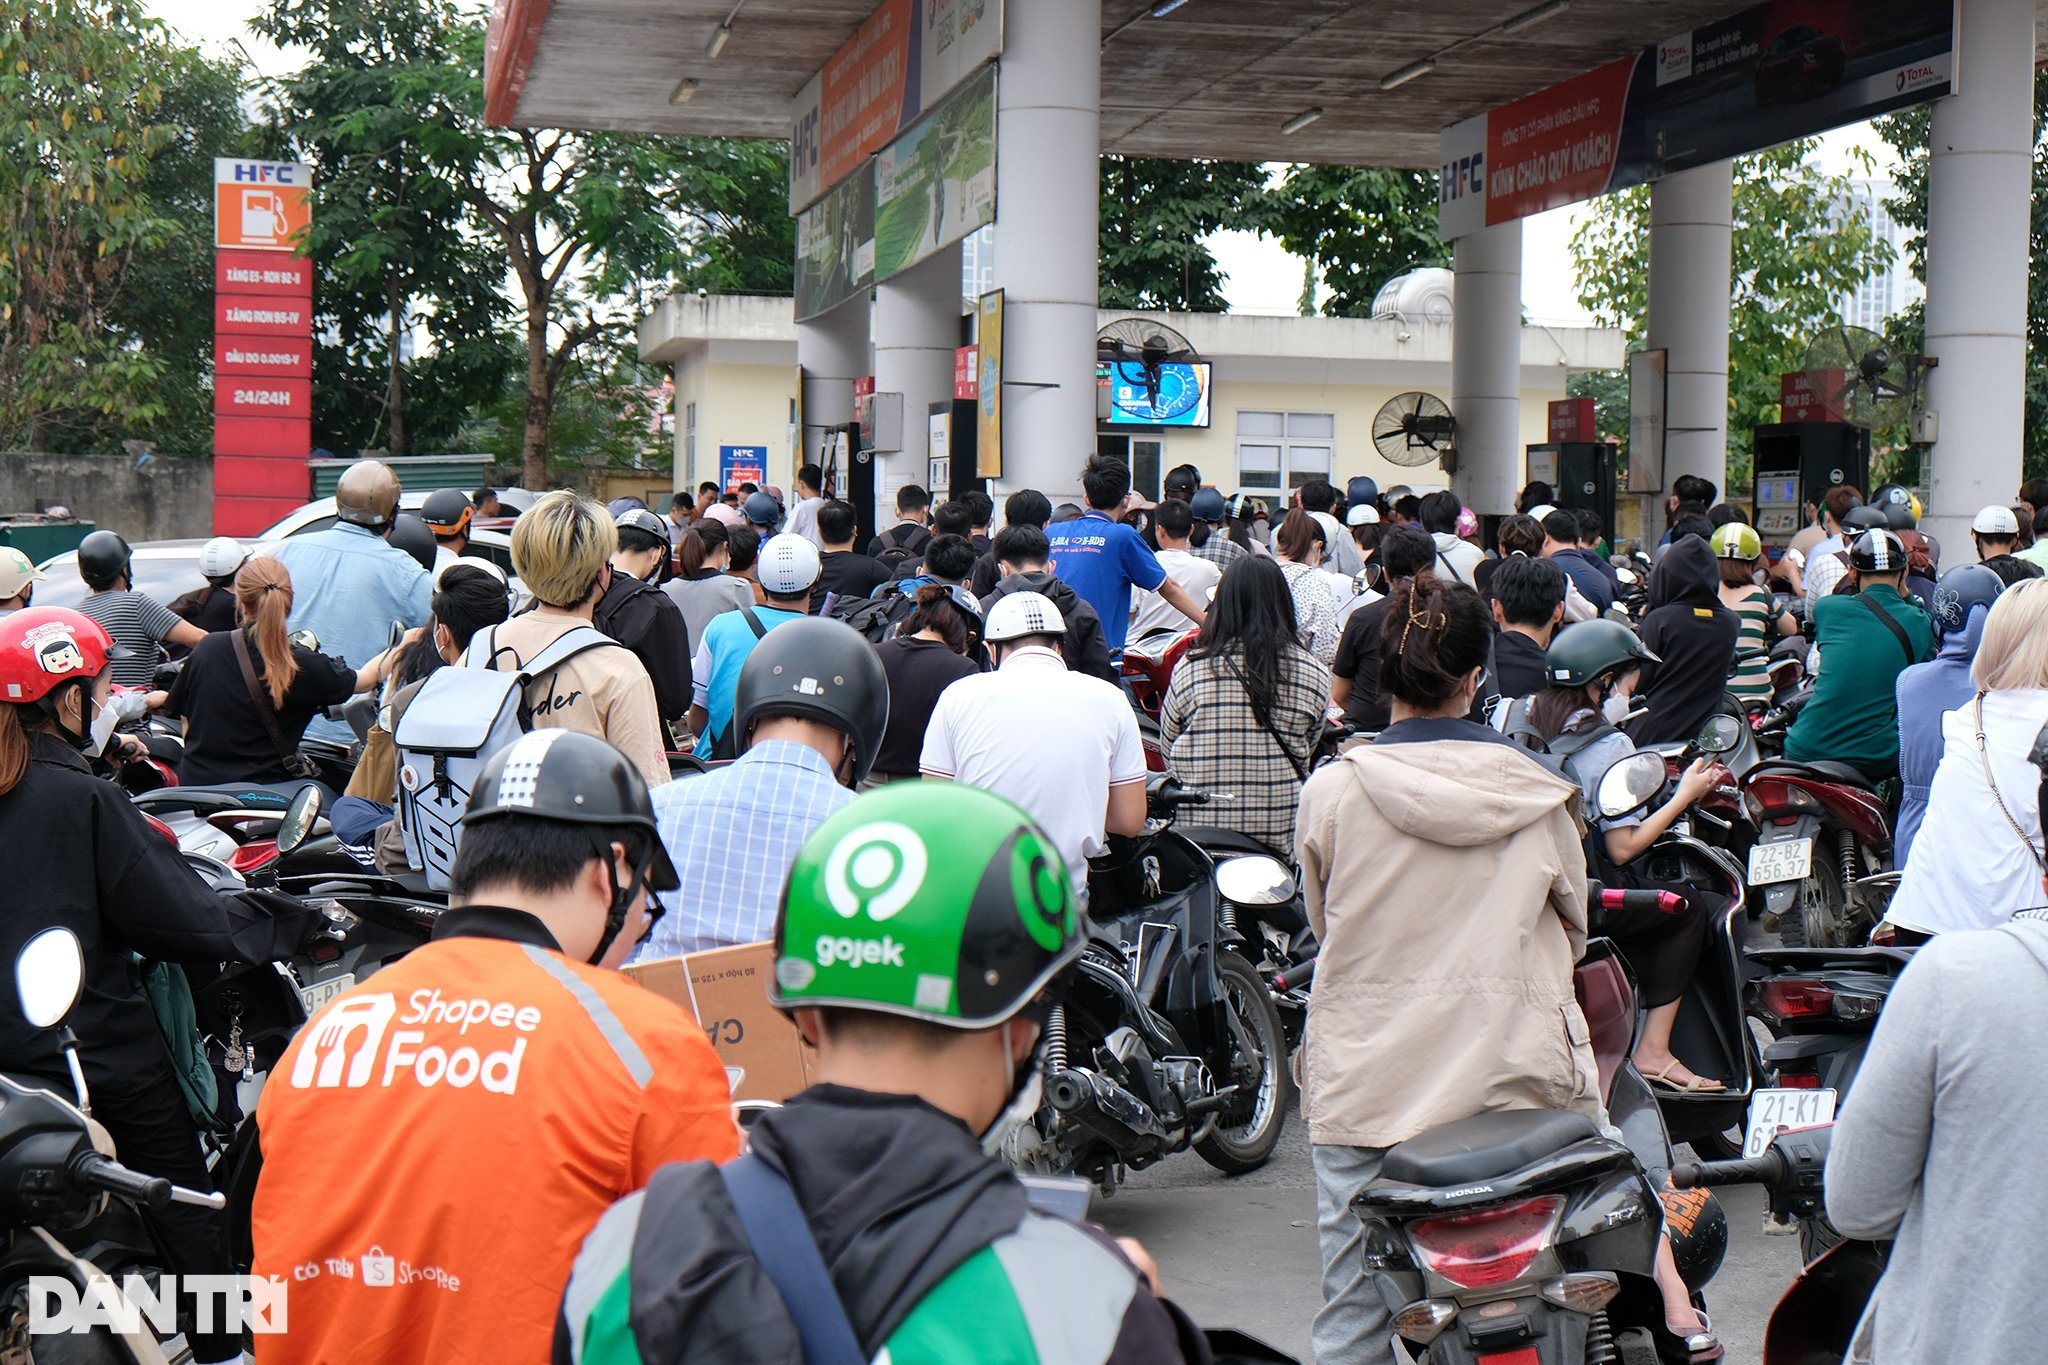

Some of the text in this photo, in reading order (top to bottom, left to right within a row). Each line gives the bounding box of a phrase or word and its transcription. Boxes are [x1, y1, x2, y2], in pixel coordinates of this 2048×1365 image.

[1667, 47, 1687, 58] TOTAL
[1906, 66, 1934, 80] TOTAL
[1520, 125, 1526, 140] TY
[1586, 97, 1600, 116] HFC
[792, 105, 818, 183] HFC
[235, 164, 293, 183] HFC
[1491, 131, 1612, 199] KÍNH CHÀO QUÝ KHÁCH
[1442, 152, 1482, 203] HFC
[234, 388, 290, 406] 24/24H
[1760, 843, 1801, 864] 22-B2
[1754, 860, 1806, 882] 656.37
[816, 934, 905, 968] gojek
[701, 974, 716, 984] 125
[726, 968, 743, 978] hộp
[744, 967, 756, 976] 80
[400, 988, 542, 1036] Shopee
[382, 1030, 528, 1096] Food
[1762, 1094, 1820, 1123] 21-K1
[1445, 1186, 1494, 1200] HONDA
[1605, 1205, 1640, 1226] PCX
[294, 1261, 320, 1282] CÓ
[324, 1256, 354, 1280] TRÊN
